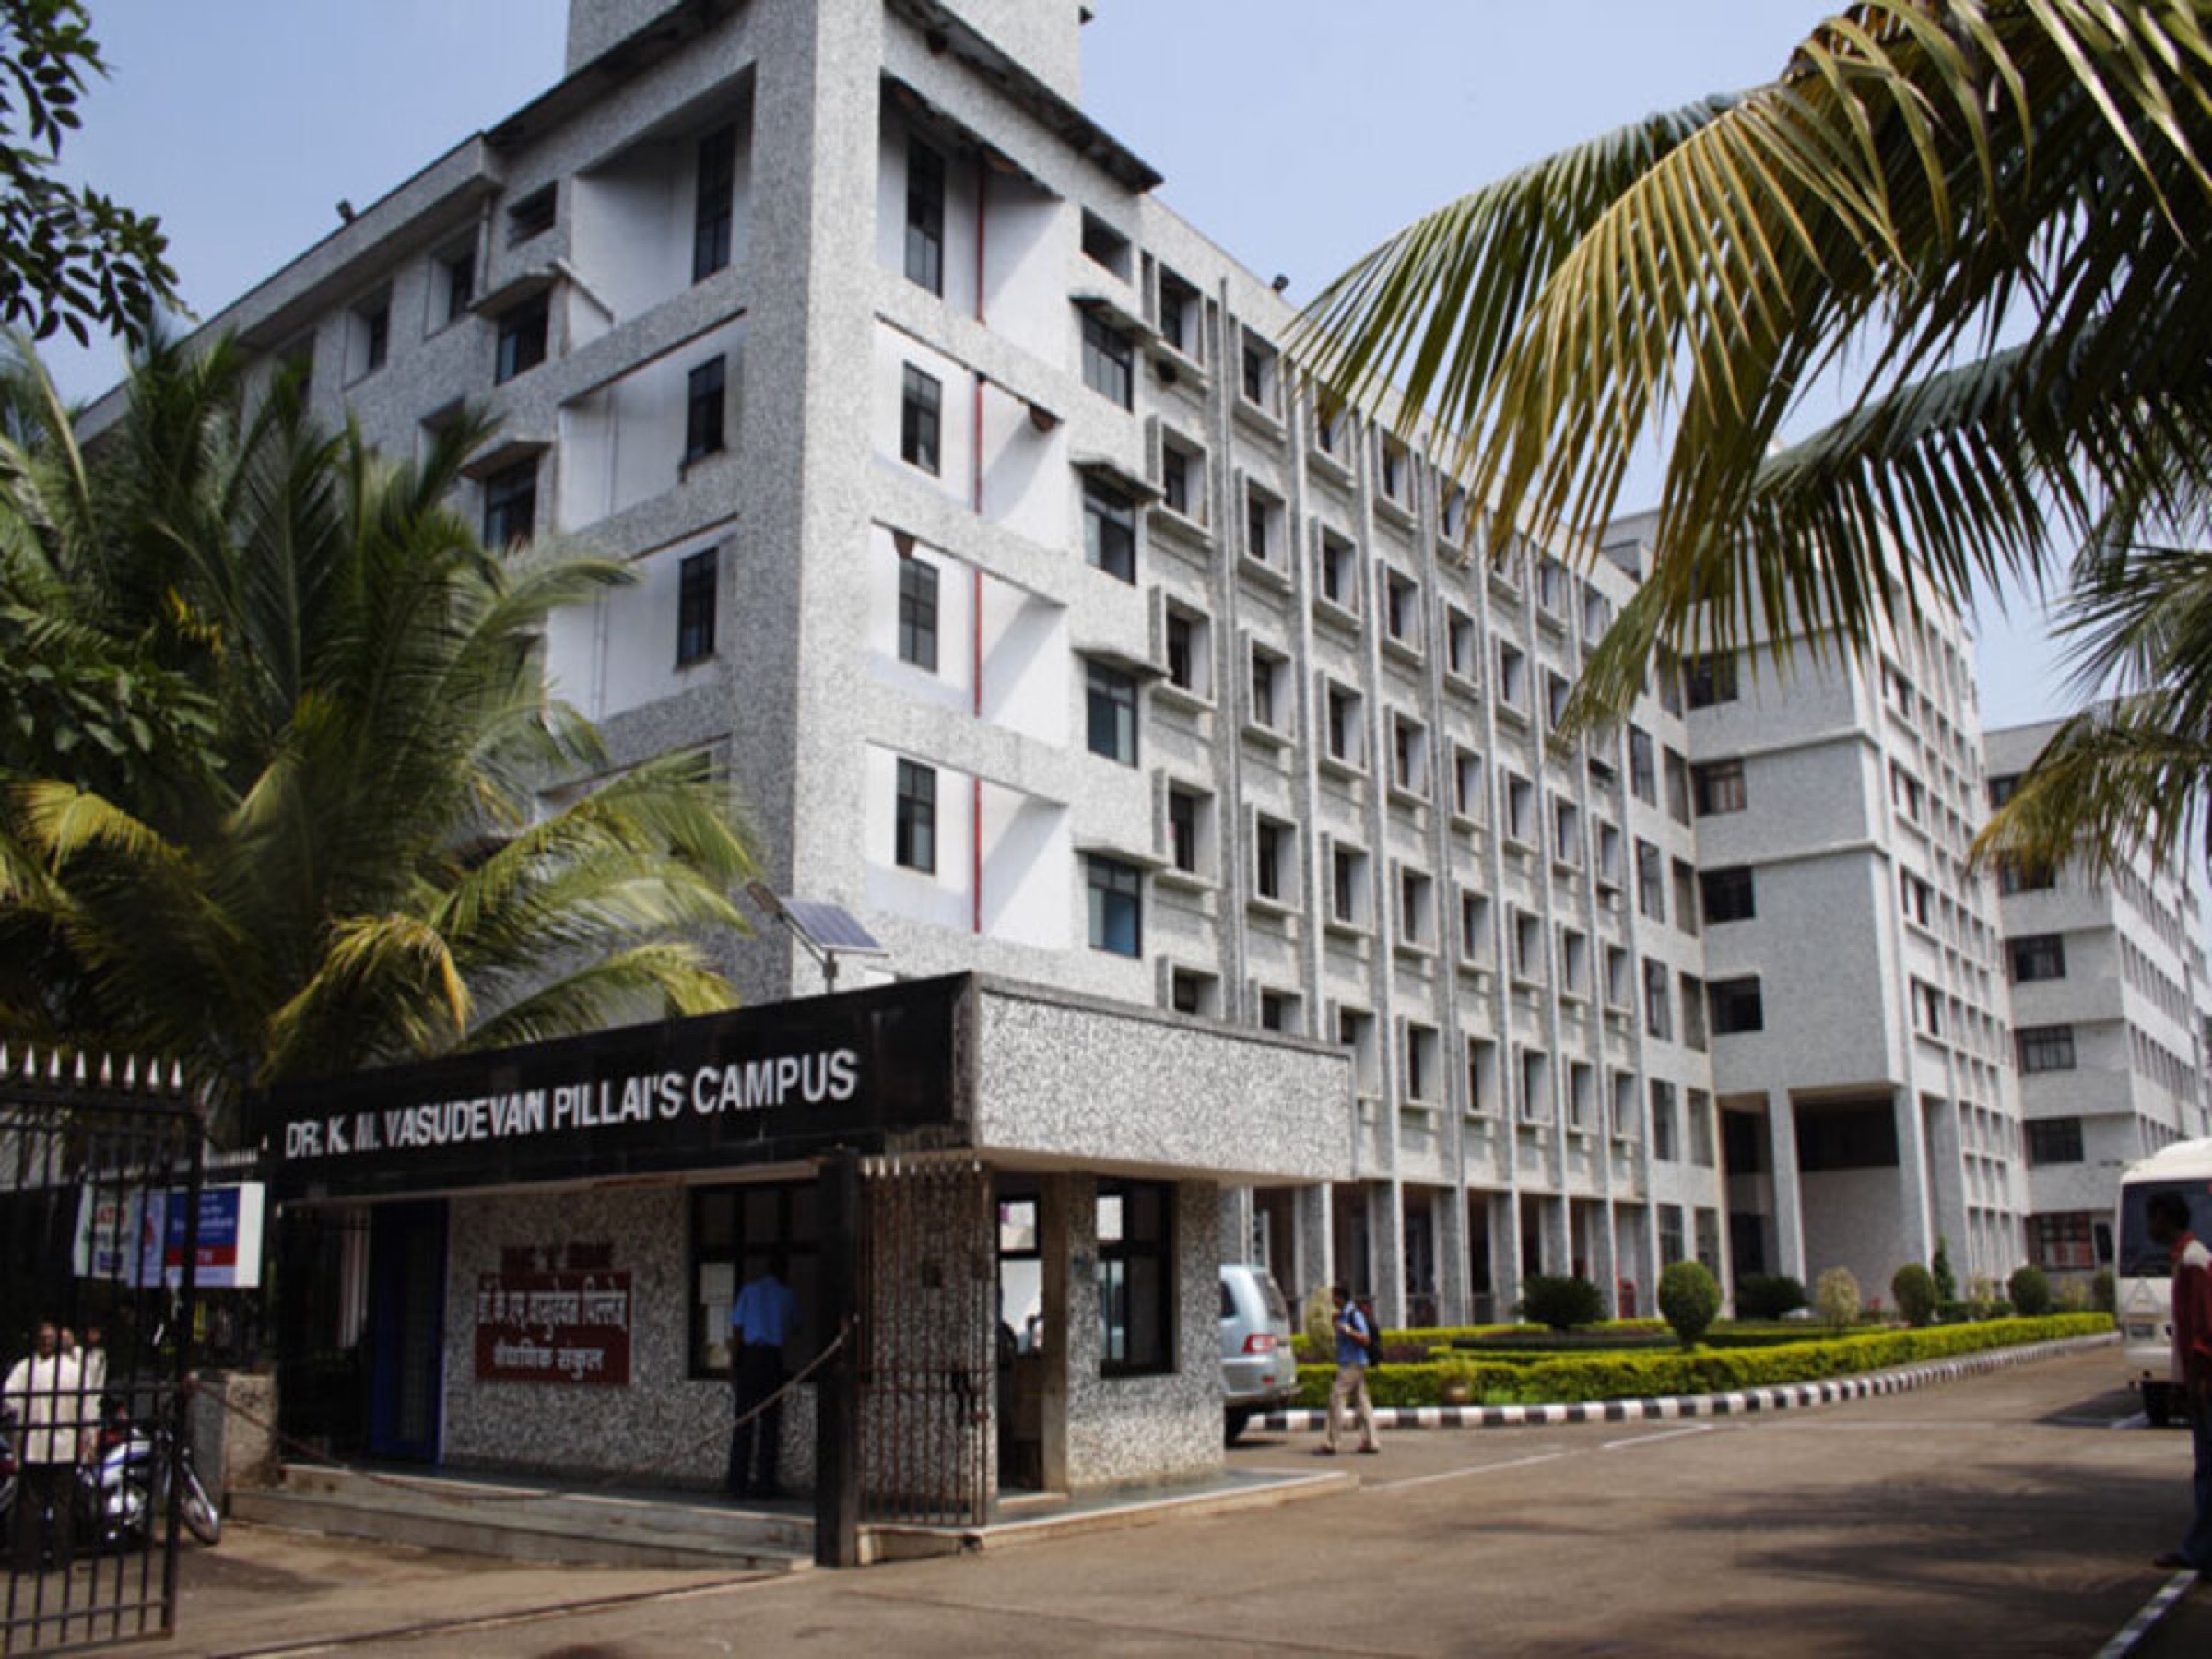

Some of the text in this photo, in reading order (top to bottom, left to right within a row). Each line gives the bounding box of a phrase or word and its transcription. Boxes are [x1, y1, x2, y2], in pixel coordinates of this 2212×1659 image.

[285, 1120, 322, 1159] DR.
[384, 1088, 546, 1148] VASUDEVAN
[552, 1071, 684, 1130] PILLAI'S
[691, 1048, 858, 1114] CAMPUS
